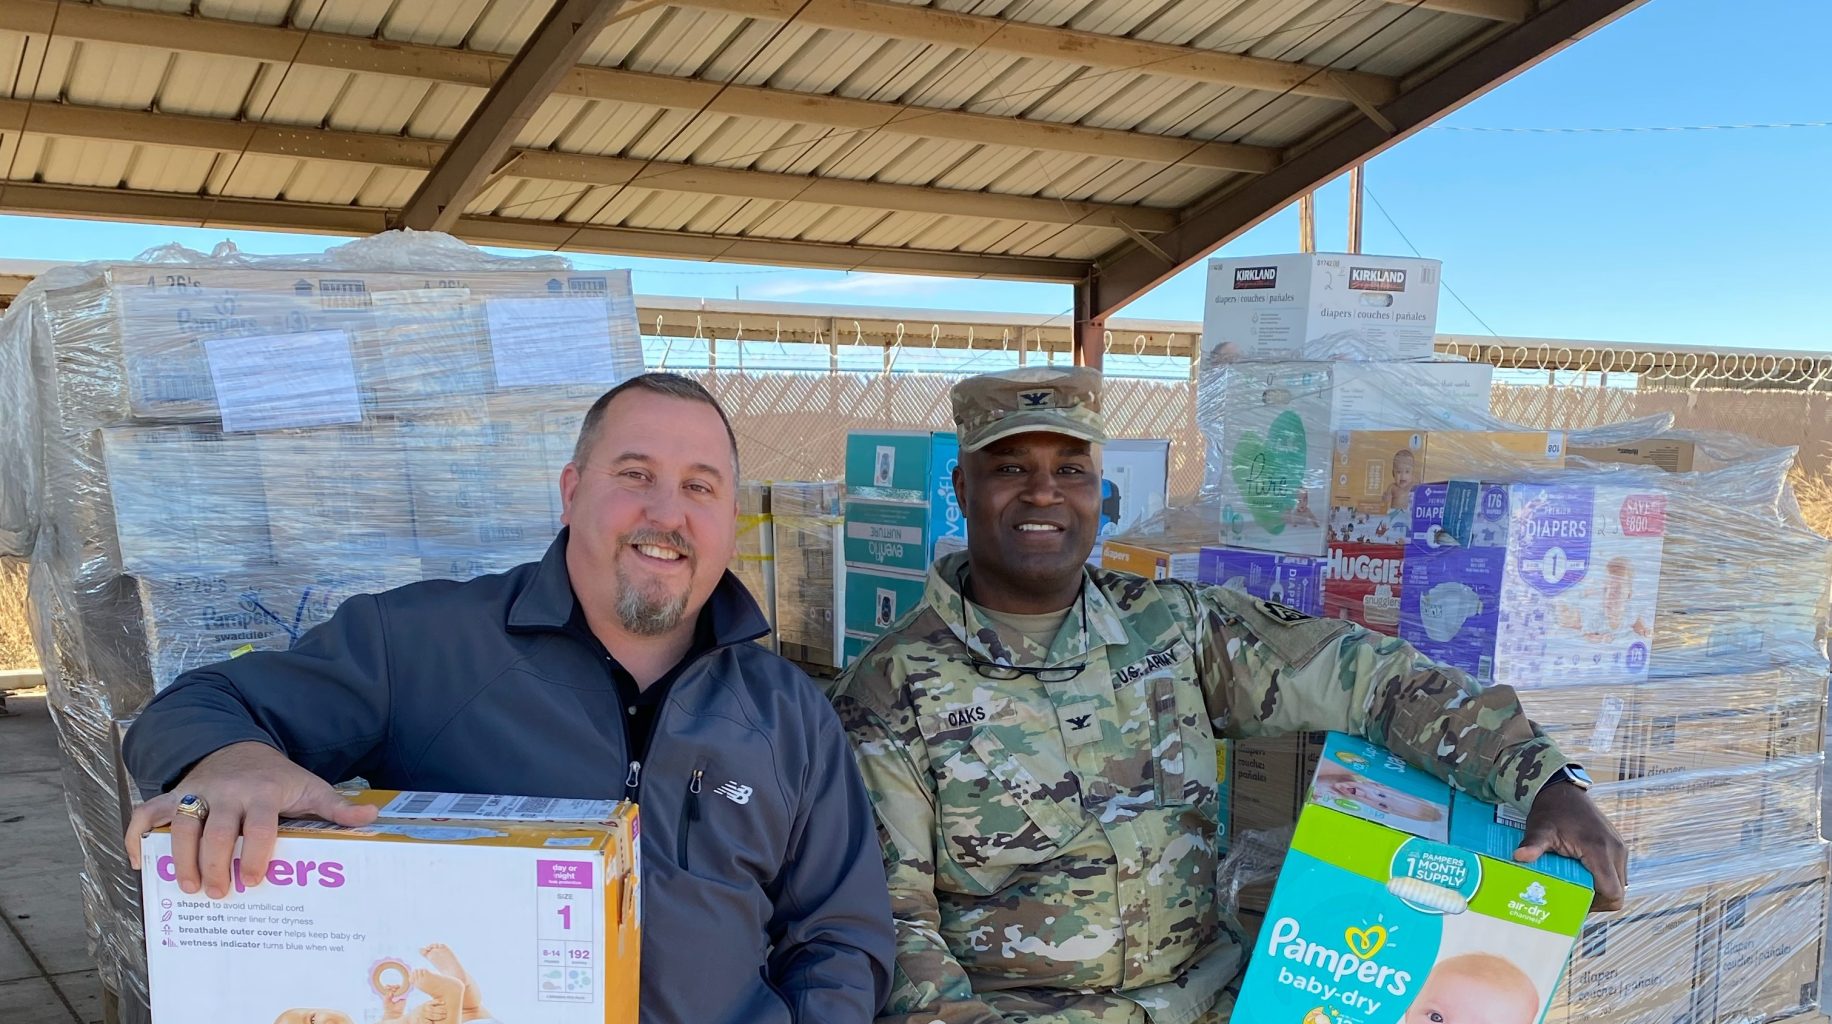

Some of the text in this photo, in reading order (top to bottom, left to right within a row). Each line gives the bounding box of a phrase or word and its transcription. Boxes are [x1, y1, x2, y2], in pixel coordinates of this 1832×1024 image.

[1236, 268, 1276, 281] KIRKLAND
[1352, 269, 1405, 284] KIRKLAND
[1215, 295, 1237, 305] diapers
[1240, 294, 1265, 303] couches
[1320, 308, 1427, 322] diapers couches pañales
[938, 457, 961, 536] venflo
[1488, 493, 1503, 508] 176
[1415, 507, 1444, 518] DIAPE
[1627, 499, 1651, 511] SAVE
[870, 526, 902, 539] NURTURE
[1526, 520, 1587, 538] DIAPERS
[868, 541, 904, 563] evenflo
[1326, 548, 1403, 585] HUGGIE
[1116, 648, 1178, 684] U.S. ARMY
[947, 706, 986, 726] OAKS
[1422, 852, 1465, 866] PAMPERS
[552, 864, 568, 873] day
[1406, 858, 1467, 877] 1 MONTH
[554, 872, 576, 880] night
[1416, 869, 1465, 887] SUPPLY
[177, 901, 211, 910] shaped
[223, 902, 246, 910] avoid
[247, 903, 284, 911] umbilical
[286, 904, 304, 912] cord
[1507, 900, 1550, 921] air-dry
[178, 914, 205, 922] super
[206, 913, 225, 921] soft
[226, 915, 247, 923] inner
[267, 916, 279, 924] for
[281, 917, 314, 926] dryness
[557, 905, 571, 930] 1
[178, 926, 228, 935] breathable
[257, 929, 283, 937] cover
[284, 929, 307, 939] helps
[308, 931, 329, 940] keep
[330, 931, 351, 941] baby
[352, 932, 366, 942] dry
[179, 939, 218, 947] wetness
[220, 940, 261, 949] indicator
[285, 942, 304, 950] blue
[305, 943, 328, 951] when
[329, 944, 345, 952] wet
[568, 949, 590, 960] 192
[1267, 916, 1412, 996] Pampers
[1278, 966, 1381, 1016] baby-dry
